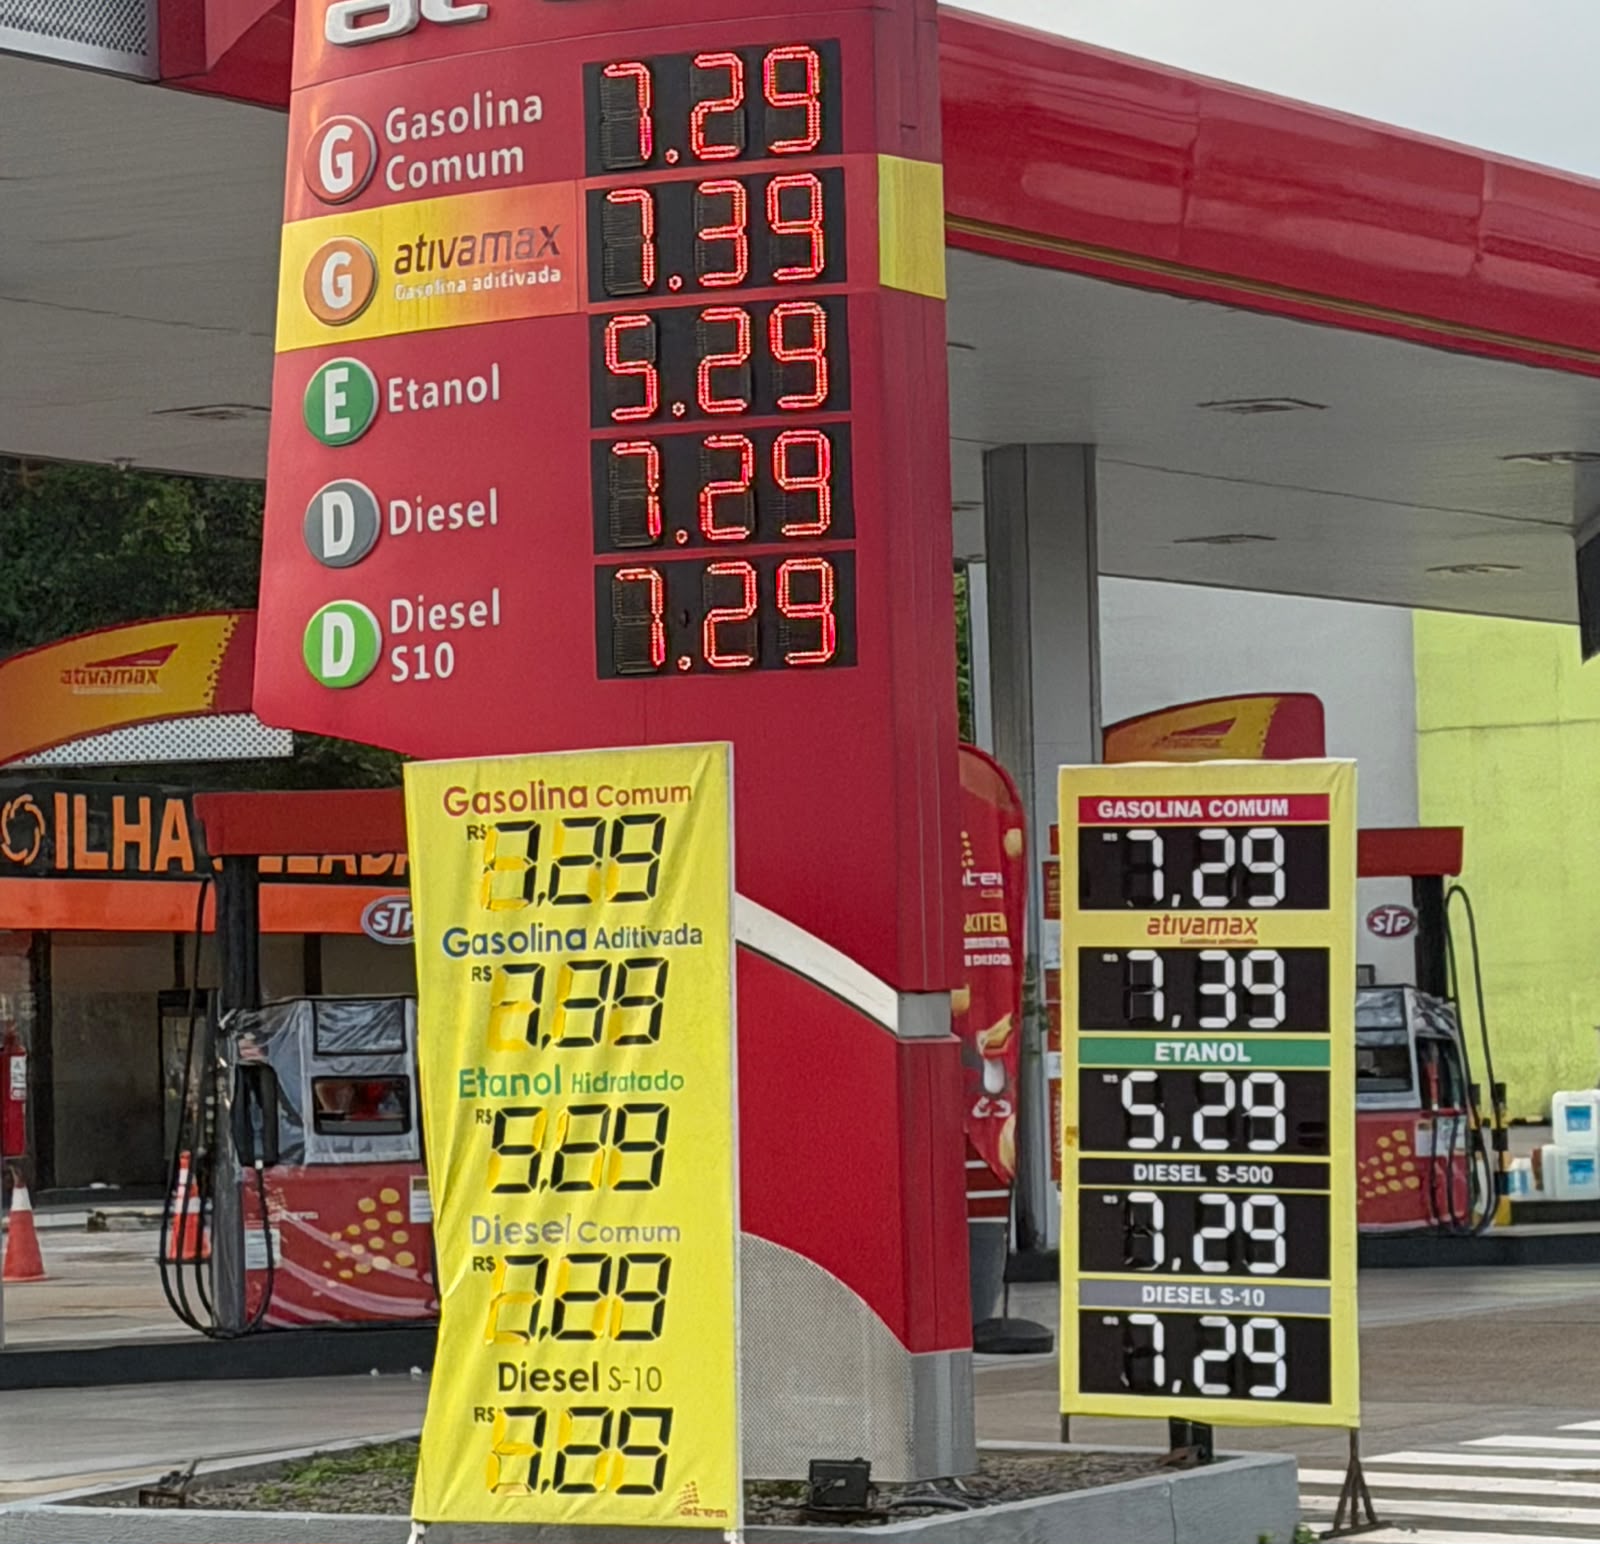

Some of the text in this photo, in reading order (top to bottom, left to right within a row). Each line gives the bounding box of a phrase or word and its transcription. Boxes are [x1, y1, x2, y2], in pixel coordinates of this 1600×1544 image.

[385, 92, 543, 144] Gasolina
[603, 45, 821, 163] 7.29
[320, 124, 353, 189] G
[385, 142, 524, 193] Comum
[394, 224, 562, 275] ativamax
[606, 173, 824, 290] 7.39
[321, 251, 353, 309] G
[395, 265, 562, 300] Gasolina aditivada
[387, 362, 500, 412] Etanol
[606, 302, 828, 420] 5.29
[324, 368, 351, 436] E
[389, 487, 499, 535] Diesel
[613, 429, 832, 541] 7.29
[323, 490, 355, 557] D
[391, 587, 501, 634] Diesel
[615, 557, 837, 669] 7.29
[322, 611, 356, 677] D
[391, 642, 456, 684] S10
[443, 779, 692, 817] Gasolina Comum
[1098, 798, 1289, 819] GASOLINA COMUM
[55, 792, 195, 872] ILHA
[467, 813, 667, 907] R$ 7,29
[1126, 827, 1286, 908] 7,29
[443, 922, 703, 958] Gasolina Aditivada
[1147, 914, 1258, 935] ativamax
[1373, 909, 1411, 934] STP
[471, 957, 669, 1050] R$ 7,39
[1127, 949, 1286, 1028] 7,39
[459, 1064, 685, 1098] Etanol Hidratado
[1154, 1042, 1252, 1063] ETANOL
[1121, 1070, 1286, 1151] 5,29
[475, 1103, 670, 1194] R$ 5,29
[1133, 1164, 1274, 1184] DIESEL S-500
[471, 1212, 681, 1245] Diesel Comum
[1127, 1191, 1287, 1274] 7,29
[472, 1252, 672, 1342] R$ 7,29
[1142, 1286, 1265, 1307] DIESEL S-10
[497, 1360, 662, 1393] Diesel S-10
[1127, 1313, 1287, 1398] 7,29
[474, 1406, 673, 1495] R$ 7,29
